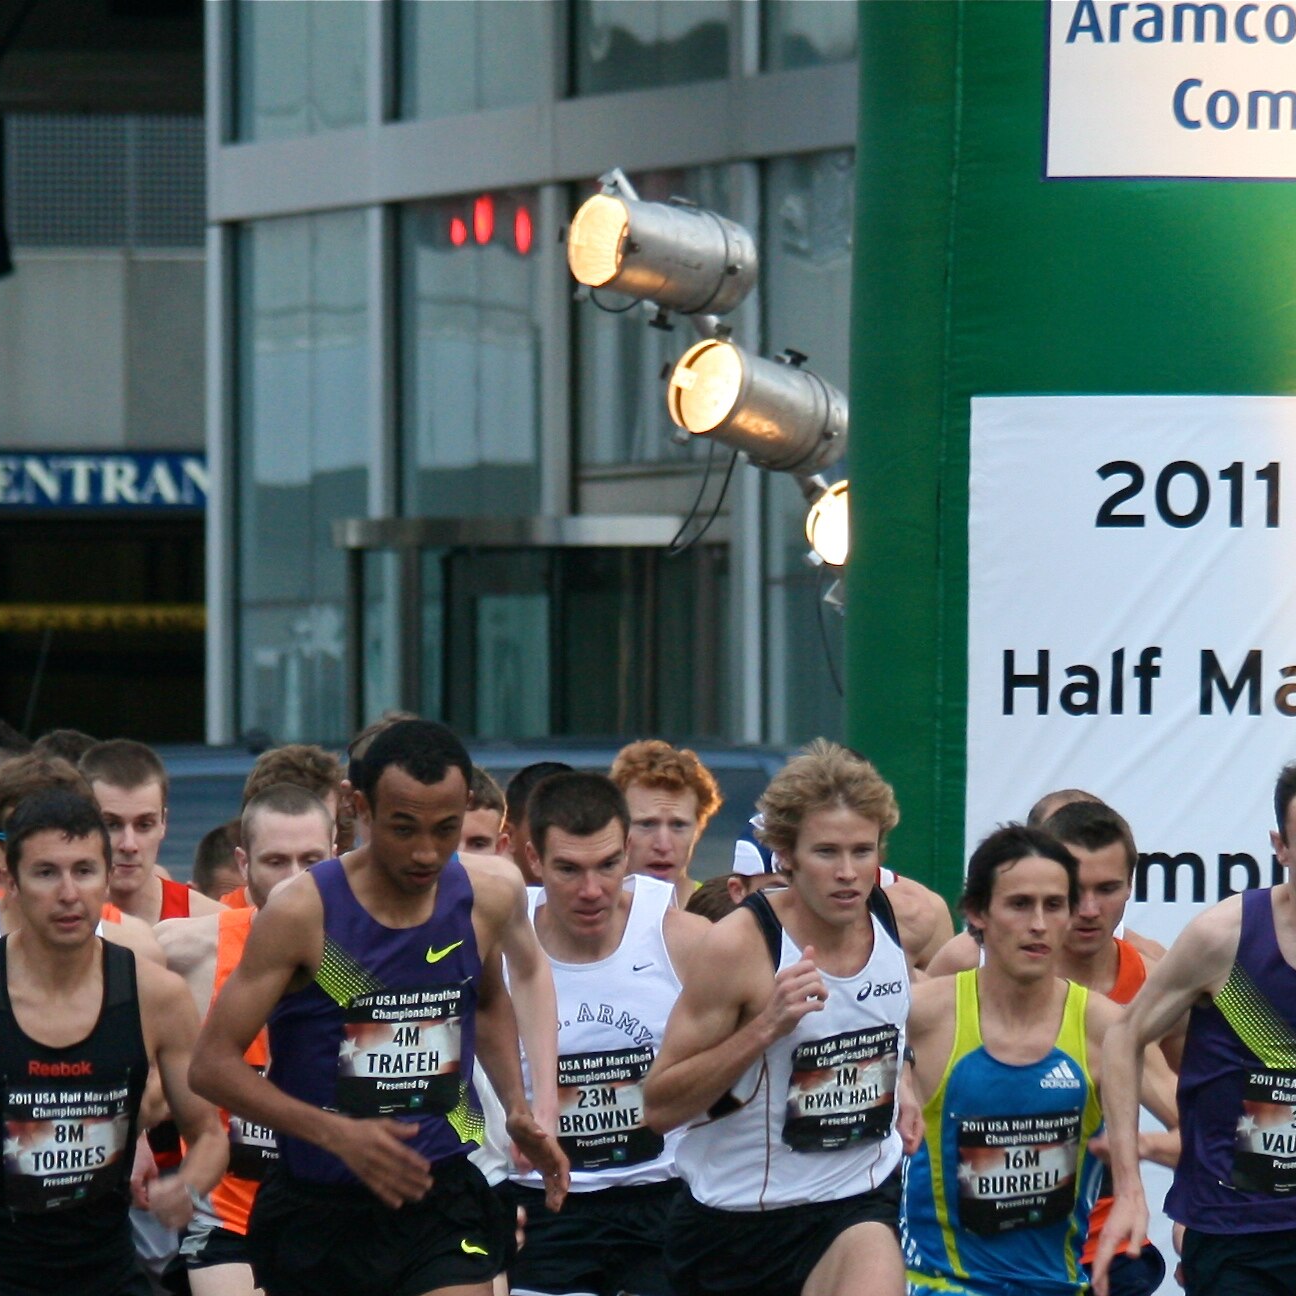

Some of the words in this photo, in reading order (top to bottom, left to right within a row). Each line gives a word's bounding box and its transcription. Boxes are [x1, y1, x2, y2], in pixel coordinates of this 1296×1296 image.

[1094, 460, 1282, 529] 2011
[1002, 646, 1162, 717] Half
[872, 981, 902, 997] asics
[352, 997, 373, 1008] 2011
[375, 995, 397, 1006] USA
[399, 993, 419, 1005] Half
[421, 990, 461, 1003] Marathon
[372, 1007, 442, 1021] Championships
[577, 1003, 653, 1045] ARMY
[393, 1026, 420, 1047] 4M
[796, 1046, 818, 1058] 2011
[820, 1042, 836, 1054] USA
[839, 1037, 857, 1050] Half
[27, 1060, 94, 1077] Reebok
[367, 1050, 440, 1074] TRAFEH
[559, 1060, 580, 1072] USA
[583, 1057, 603, 1070] Half
[606, 1052, 652, 1066] Marathon
[376, 1080, 417, 1091] Presented
[418, 1079, 429, 1090] By
[559, 1069, 632, 1084] Championships
[1039, 1077, 1081, 1089] adidas
[1249, 1074, 1273, 1086] 2011
[8, 1092, 32, 1105] 2011
[34, 1092, 57, 1105] USA
[60, 1091, 81, 1104] Half
[84, 1088, 128, 1102] Marathon
[577, 1086, 618, 1109] 23M
[804, 1093, 843, 1110] RYAN
[849, 1084, 881, 1105] HALL
[32, 1105, 109, 1118] Championships
[559, 1107, 641, 1133] BROWNE
[962, 1120, 985, 1132] 2011
[987, 1120, 1009, 1132] USA
[1012, 1119, 1032, 1131] Half
[1035, 1115, 1079, 1130] Marathon
[54, 1124, 84, 1143] 8M
[576, 1136, 616, 1147] Presented
[617, 1134, 628, 1144] By
[985, 1132, 1058, 1146] Championships
[31, 1146, 107, 1172] TORRES
[1004, 1149, 1040, 1170] 16M
[43, 1174, 82, 1187] Presented
[978, 1169, 1060, 1195] BURRELL
[996, 1198, 1035, 1210] Presented
